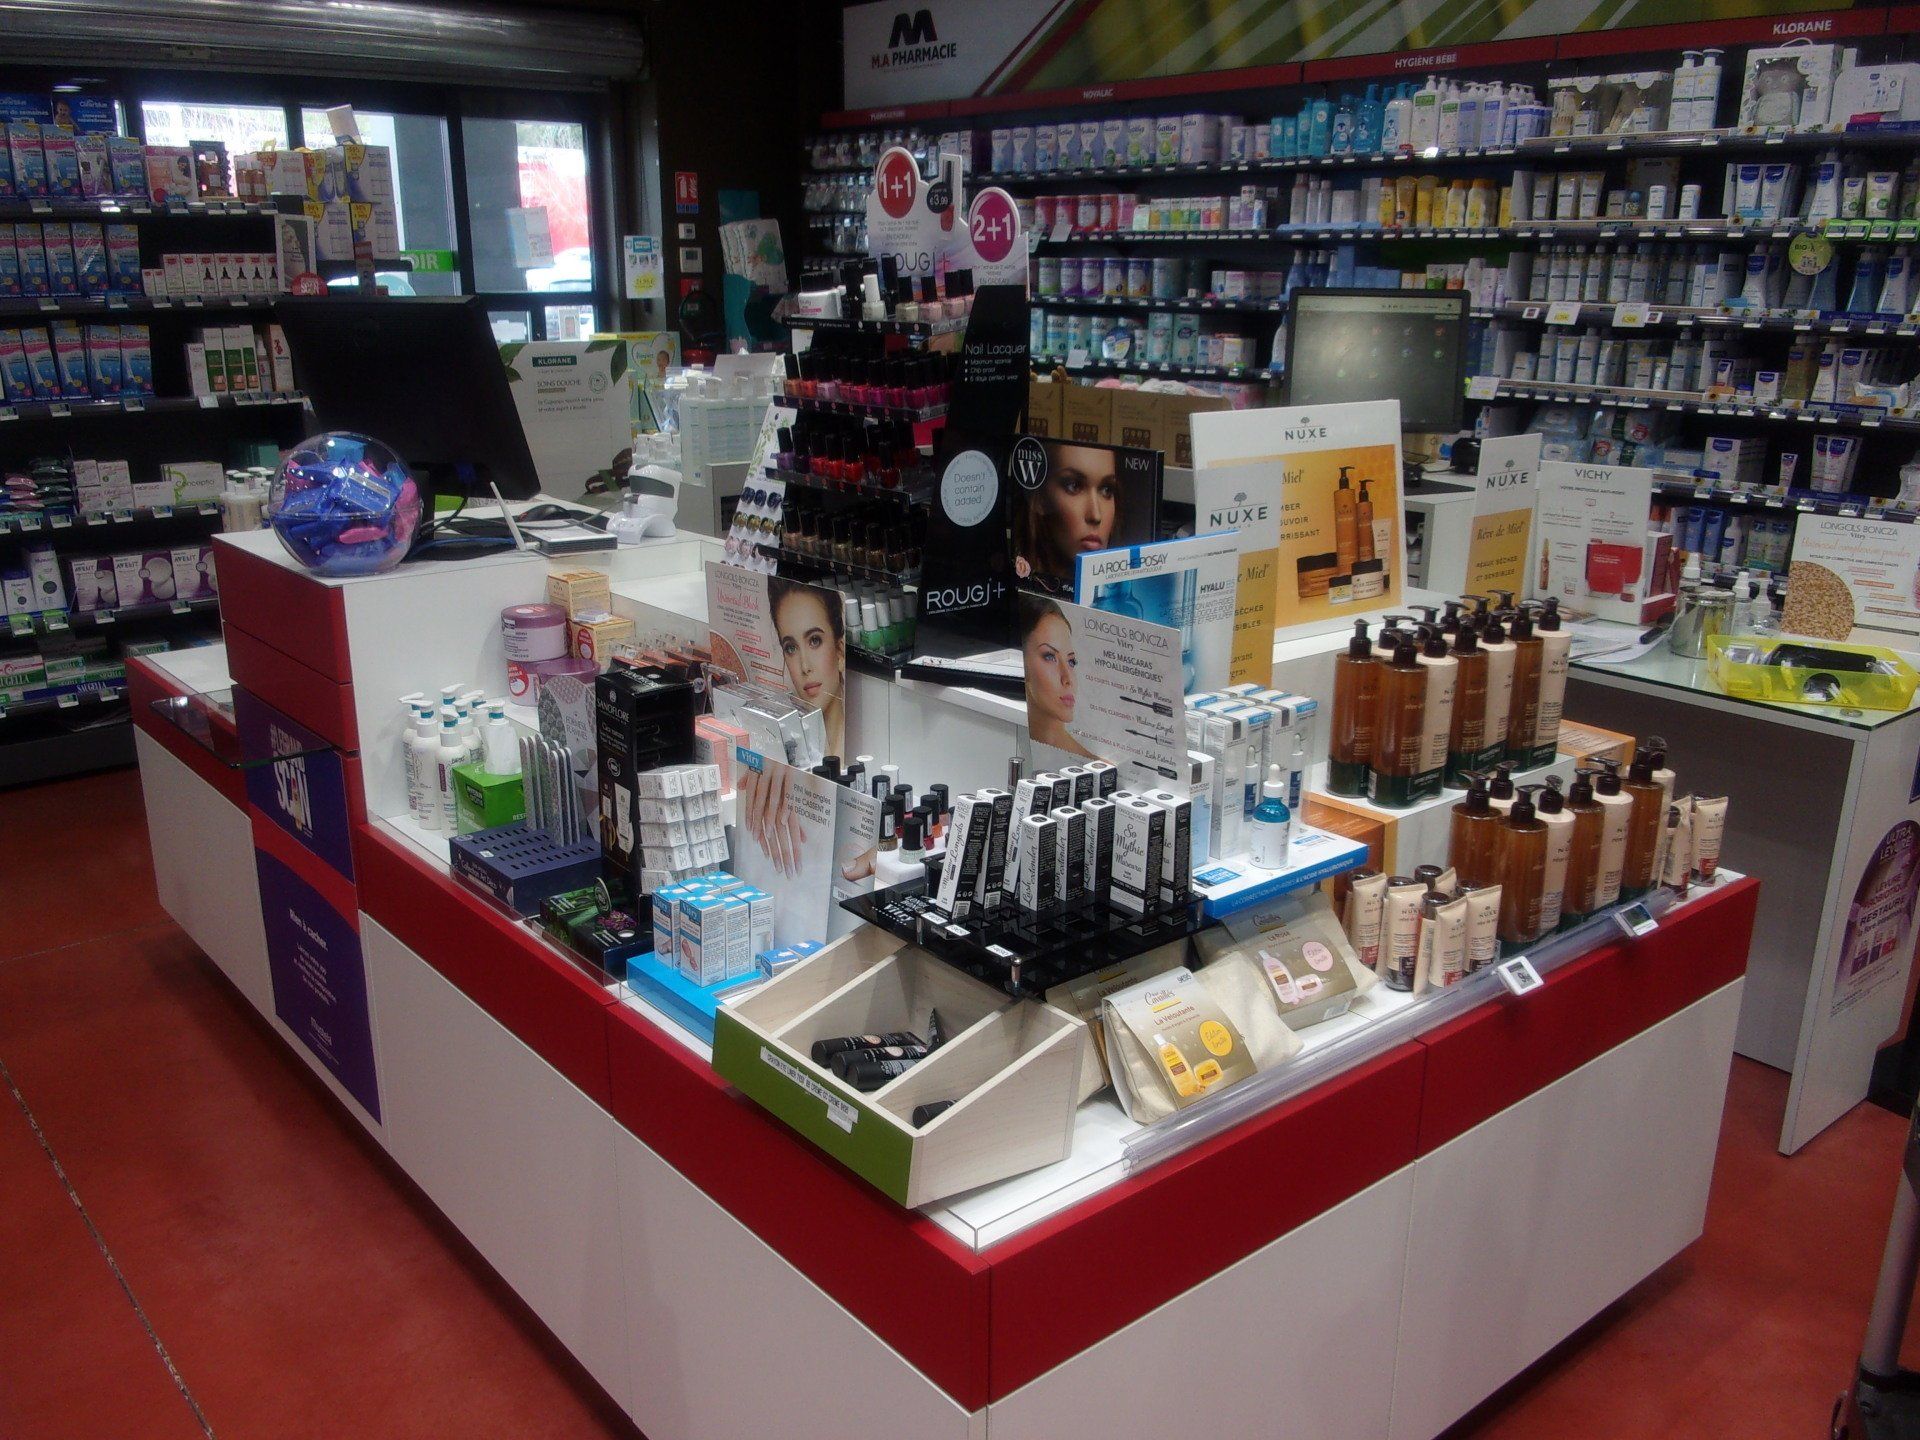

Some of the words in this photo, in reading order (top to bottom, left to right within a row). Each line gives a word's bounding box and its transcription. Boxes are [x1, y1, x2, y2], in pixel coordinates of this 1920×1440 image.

[1772, 19, 1833, 35] KLORANE
[892, 43, 957, 66] PHARMACIE
[1083, 88, 1114, 99] NOVALAC
[878, 171, 912, 199] 1+1
[973, 213, 1012, 242] 2+1
[965, 343, 984, 355] Nail
[986, 343, 1027, 357] Lacquer
[537, 357, 572, 365] KLORANE
[557, 379, 582, 387] DOUCHE
[1284, 427, 1328, 441] NUXE
[1018, 445, 1042, 461] miss
[1017, 459, 1042, 484] W
[1125, 457, 1150, 472] NEW
[954, 472, 986, 483] Doesn't
[1486, 472, 1529, 489] NUXE
[1575, 468, 1612, 480] VICHY
[954, 483, 985, 495] contain
[954, 496, 982, 506] added
[1210, 506, 1268, 527] NUXE
[1820, 521, 1861, 532] LONGCILS
[1862, 525, 1898, 536] BONCZA
[1092, 561, 1106, 576] LA
[1200, 581, 1225, 594] HYALU
[1084, 618, 1128, 639] LONGCILS
[1129, 629, 1169, 649] BONCZA
[1117, 638, 1134, 651] Vitry
[1103, 650, 1116, 660] MES
[1117, 654, 1153, 670] MASCARAS
[597, 700, 630, 723] SANOFLORE
[741, 750, 760, 766] Vitry
[1124, 823, 1137, 839] So
[1114, 833, 1145, 858] Mythic
[1115, 852, 1143, 873] Mascara
[1154, 1018, 1163, 1026] La
[1163, 1005, 1195, 1022] Veloutante
